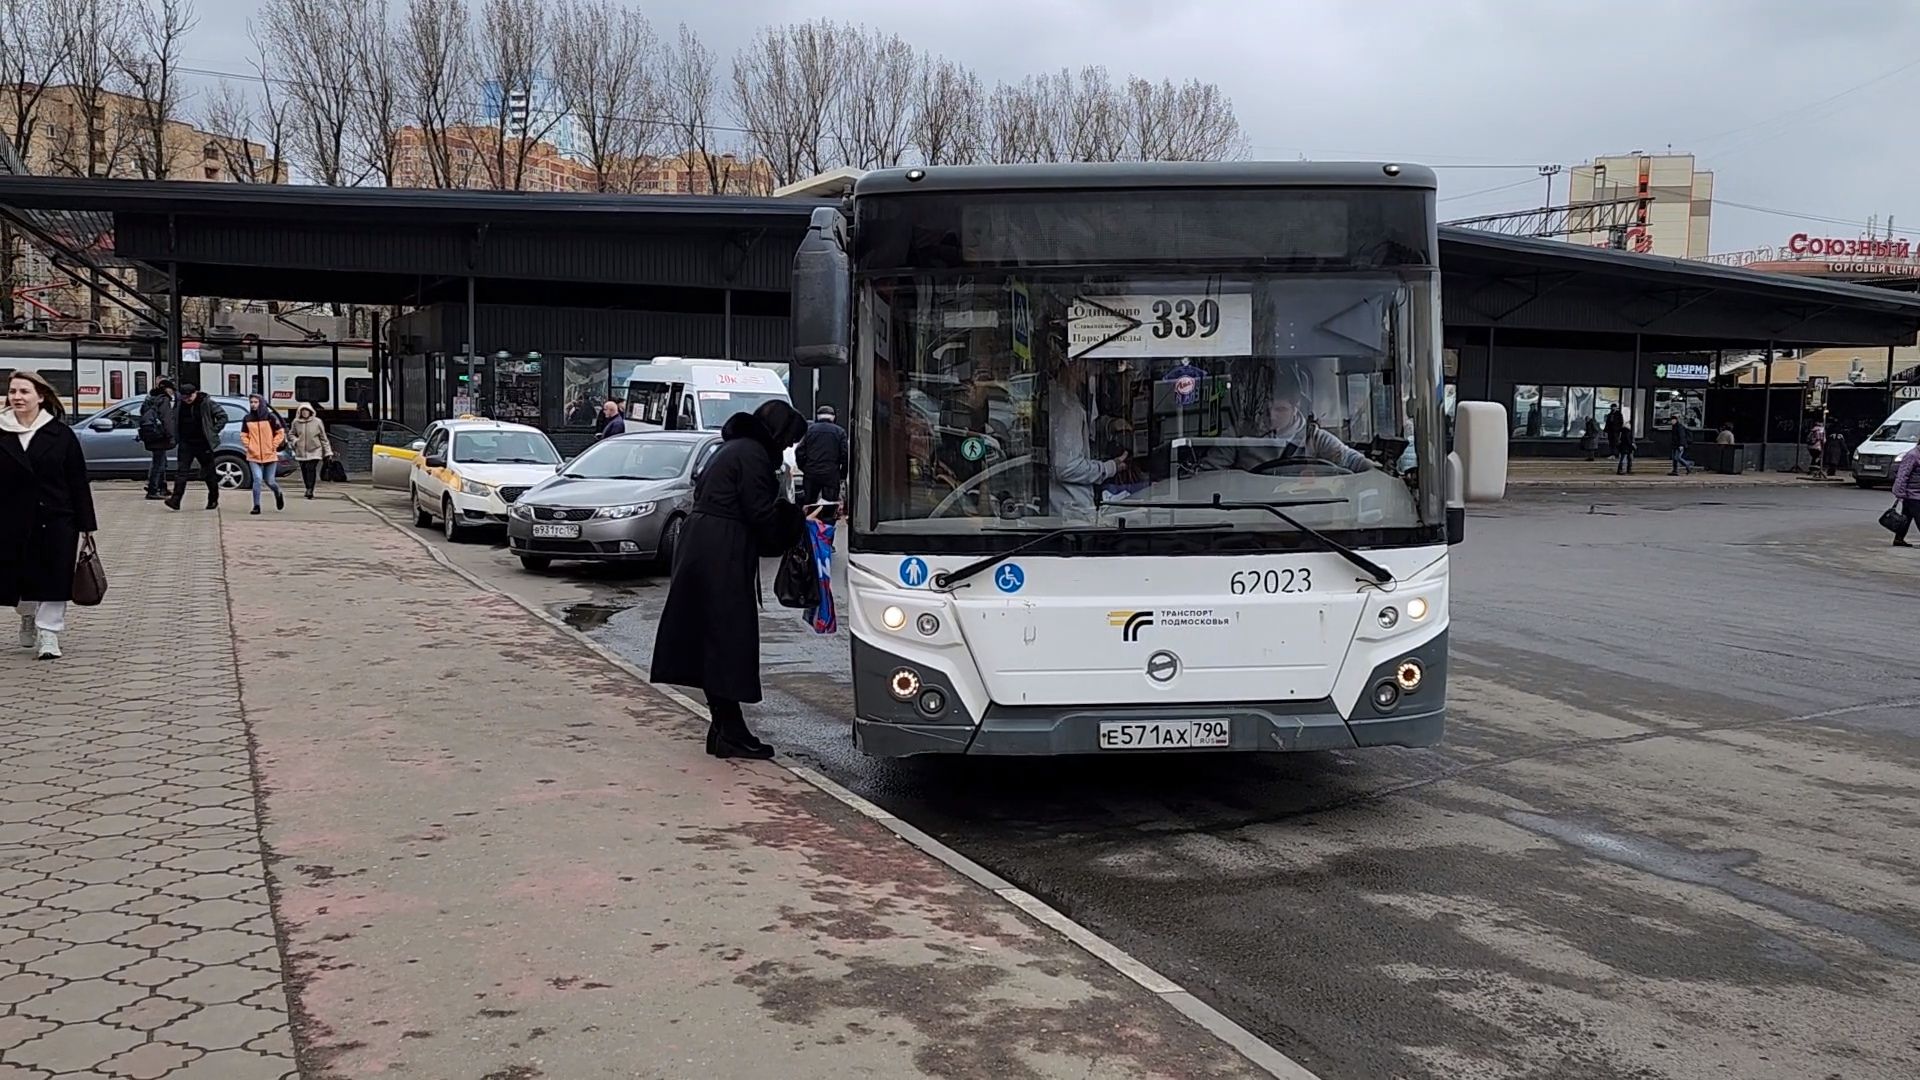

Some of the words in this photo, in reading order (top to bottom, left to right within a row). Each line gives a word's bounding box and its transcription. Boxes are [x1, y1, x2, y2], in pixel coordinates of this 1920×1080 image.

[1828, 262, 1885, 273] ТОРГОВЫЙ
[1889, 266, 1920, 275] ЦЕНТР
[1152, 299, 1220, 339] 339
[1073, 333, 1100, 344] Парк
[1103, 333, 1142, 343] Пбеды
[1667, 364, 1709, 374] ШАУРМА
[1231, 568, 1312, 595] 62023
[1161, 609, 1213, 617] ТРАНСПОРТ
[1161, 618, 1230, 626] ПОДМОСКОВЬЯ
[1193, 722, 1224, 739] 790
